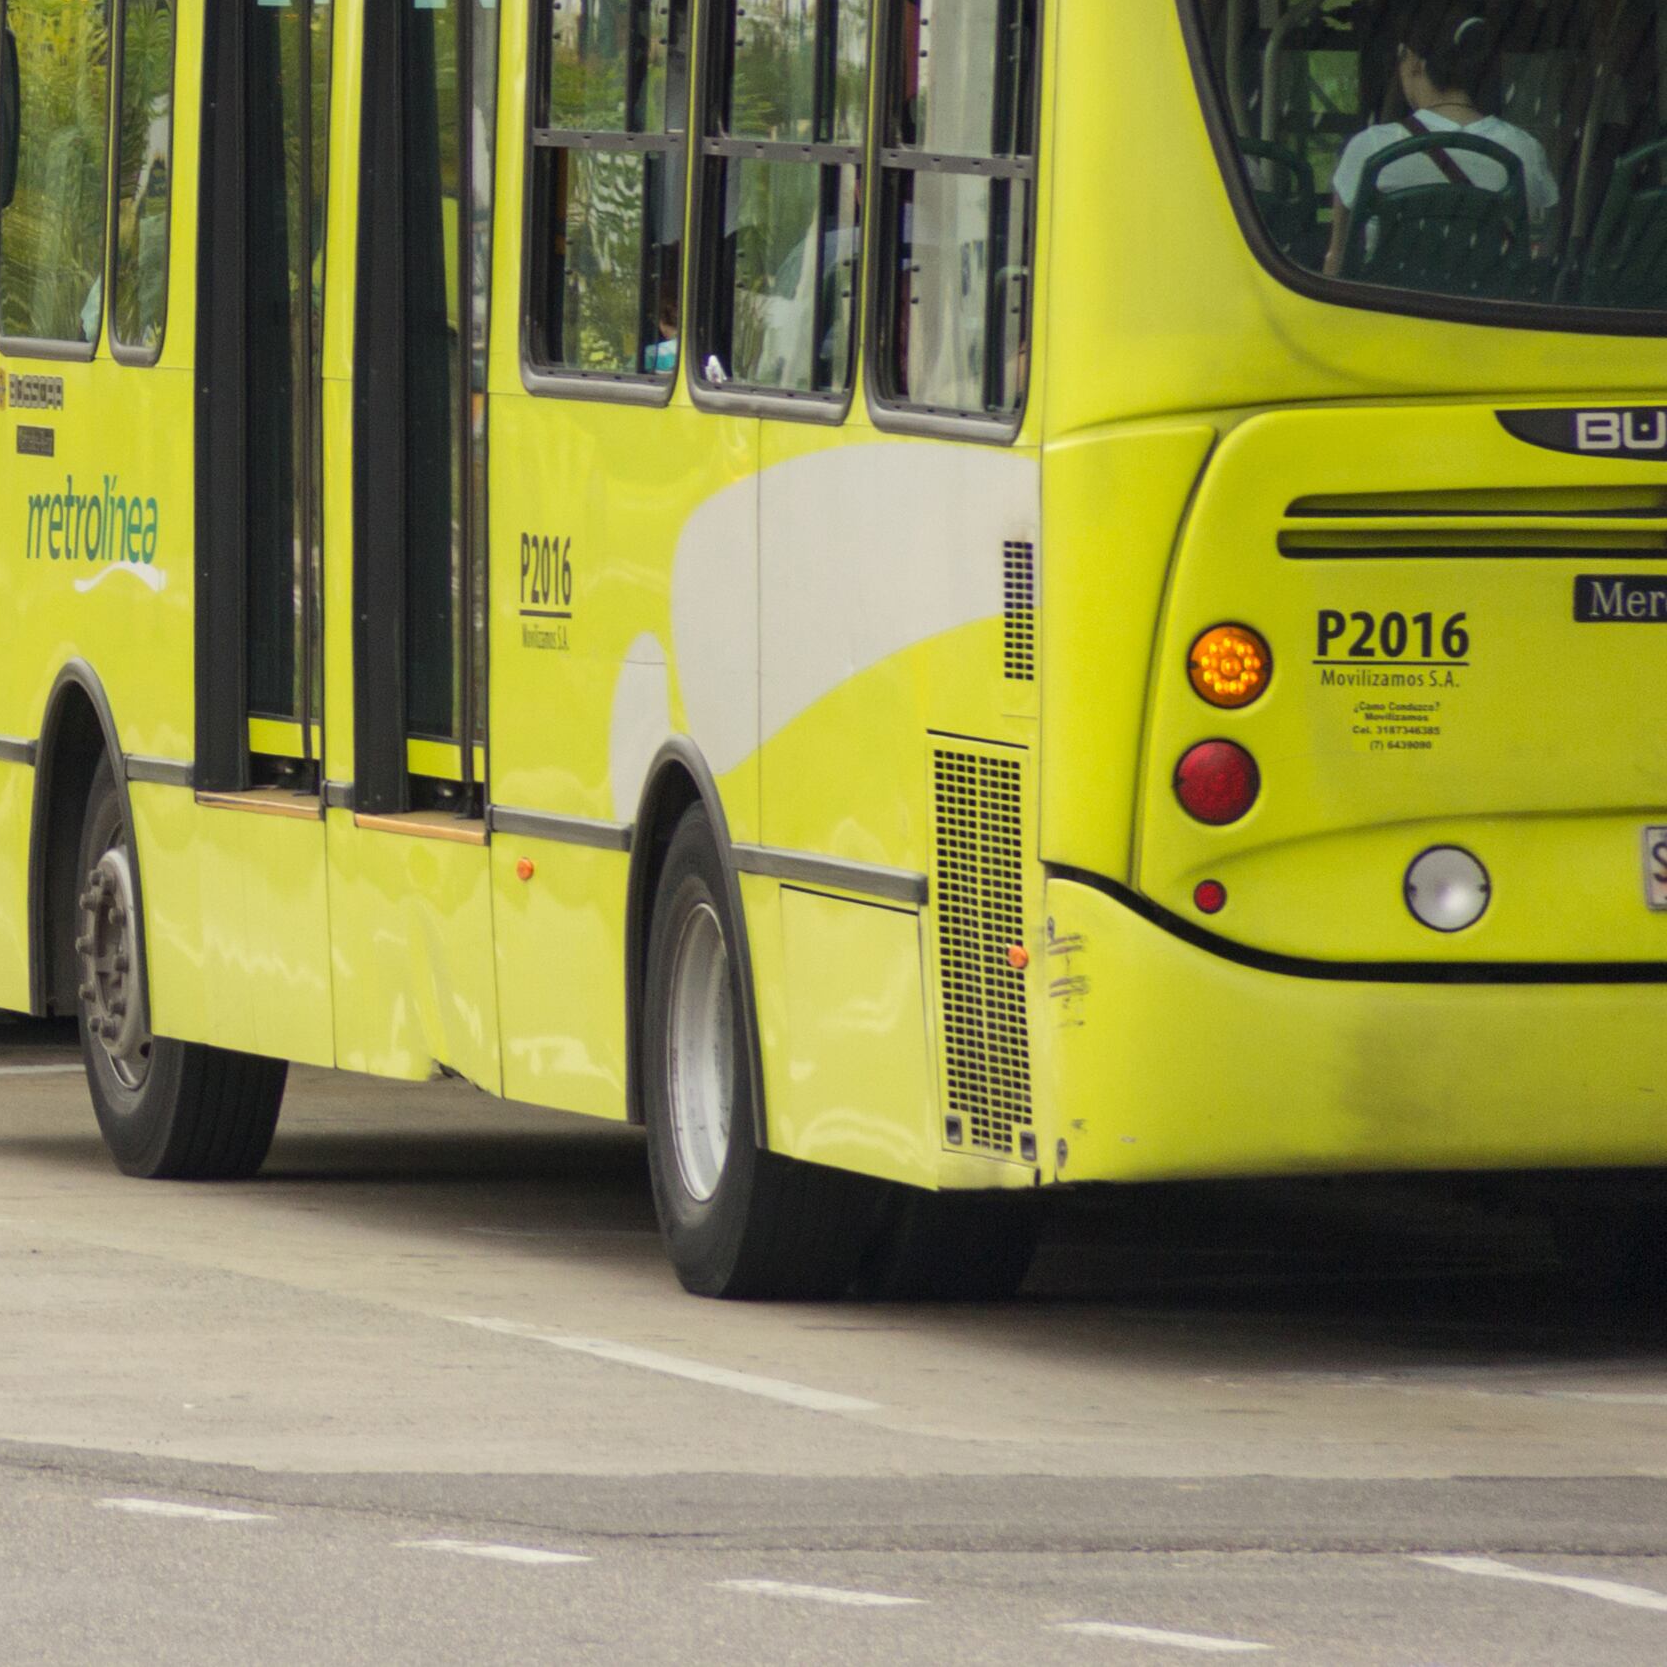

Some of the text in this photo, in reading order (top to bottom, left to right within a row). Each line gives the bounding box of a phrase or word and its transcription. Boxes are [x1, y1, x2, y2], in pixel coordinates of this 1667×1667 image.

[1577, 411, 1667, 450] BU
[27, 474, 158, 564] metrolínea
[520, 532, 572, 606] P2016
[1317, 609, 1469, 658] P2016
[1321, 669, 1461, 688] Movilizamos S.A.
